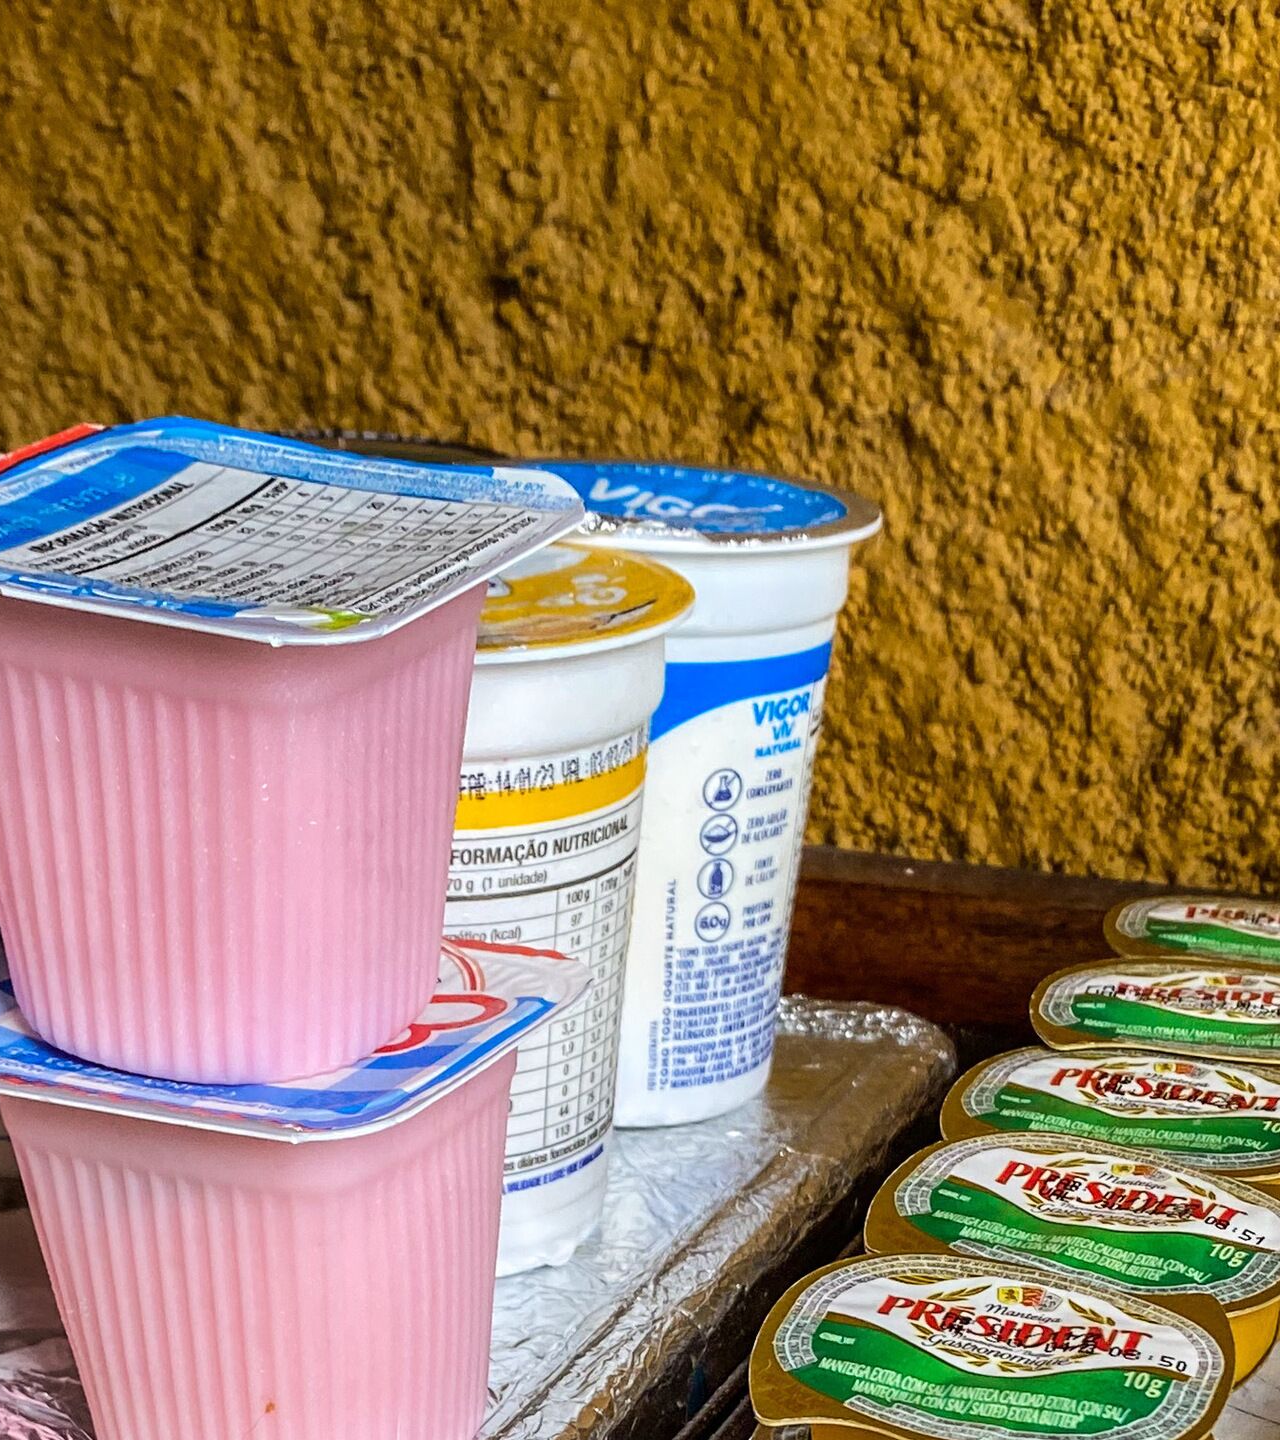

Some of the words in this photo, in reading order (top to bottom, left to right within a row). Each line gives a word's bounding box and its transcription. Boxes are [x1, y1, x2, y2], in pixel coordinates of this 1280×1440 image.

[752, 691, 811, 727] VIGOR
[754, 738, 801, 758] NATURAL
[552, 814, 628, 855] NUTRICIONAL
[498, 870, 548, 889] unidade)
[570, 912, 583, 927] 97
[490, 925, 522, 944] (kcal)
[570, 934, 583, 947] 14
[561, 1020, 577, 1036] 3,2
[994, 1159, 1249, 1223] PRÉSIDENT
[931, 1209, 980, 1228] MANTEIGA
[1209, 1242, 1251, 1269] 10g
[876, 1293, 1154, 1357] PRÉSIDENT
[983, 1302, 1064, 1325] Manteiga
[819, 1356, 870, 1381] MANTEIGA
[869, 1366, 903, 1388] EXTRA
[901, 1373, 928, 1396] COM
[927, 1381, 952, 1399] SAL/
[951, 1384, 1001, 1405] MANTECA
[1001, 1388, 1045, 1408] CALIDAD
[1044, 1391, 1078, 1414] EXTRA
[1076, 1400, 1103, 1419] CON
[1103, 1405, 1131, 1427] SAL/
[1122, 1369, 1166, 1399] 10g
[851, 1378, 921, 1406] MANTEQUILLA
[970, 1401, 1008, 1420] SALTED
[1006, 1406, 1040, 1424] EXTRA
